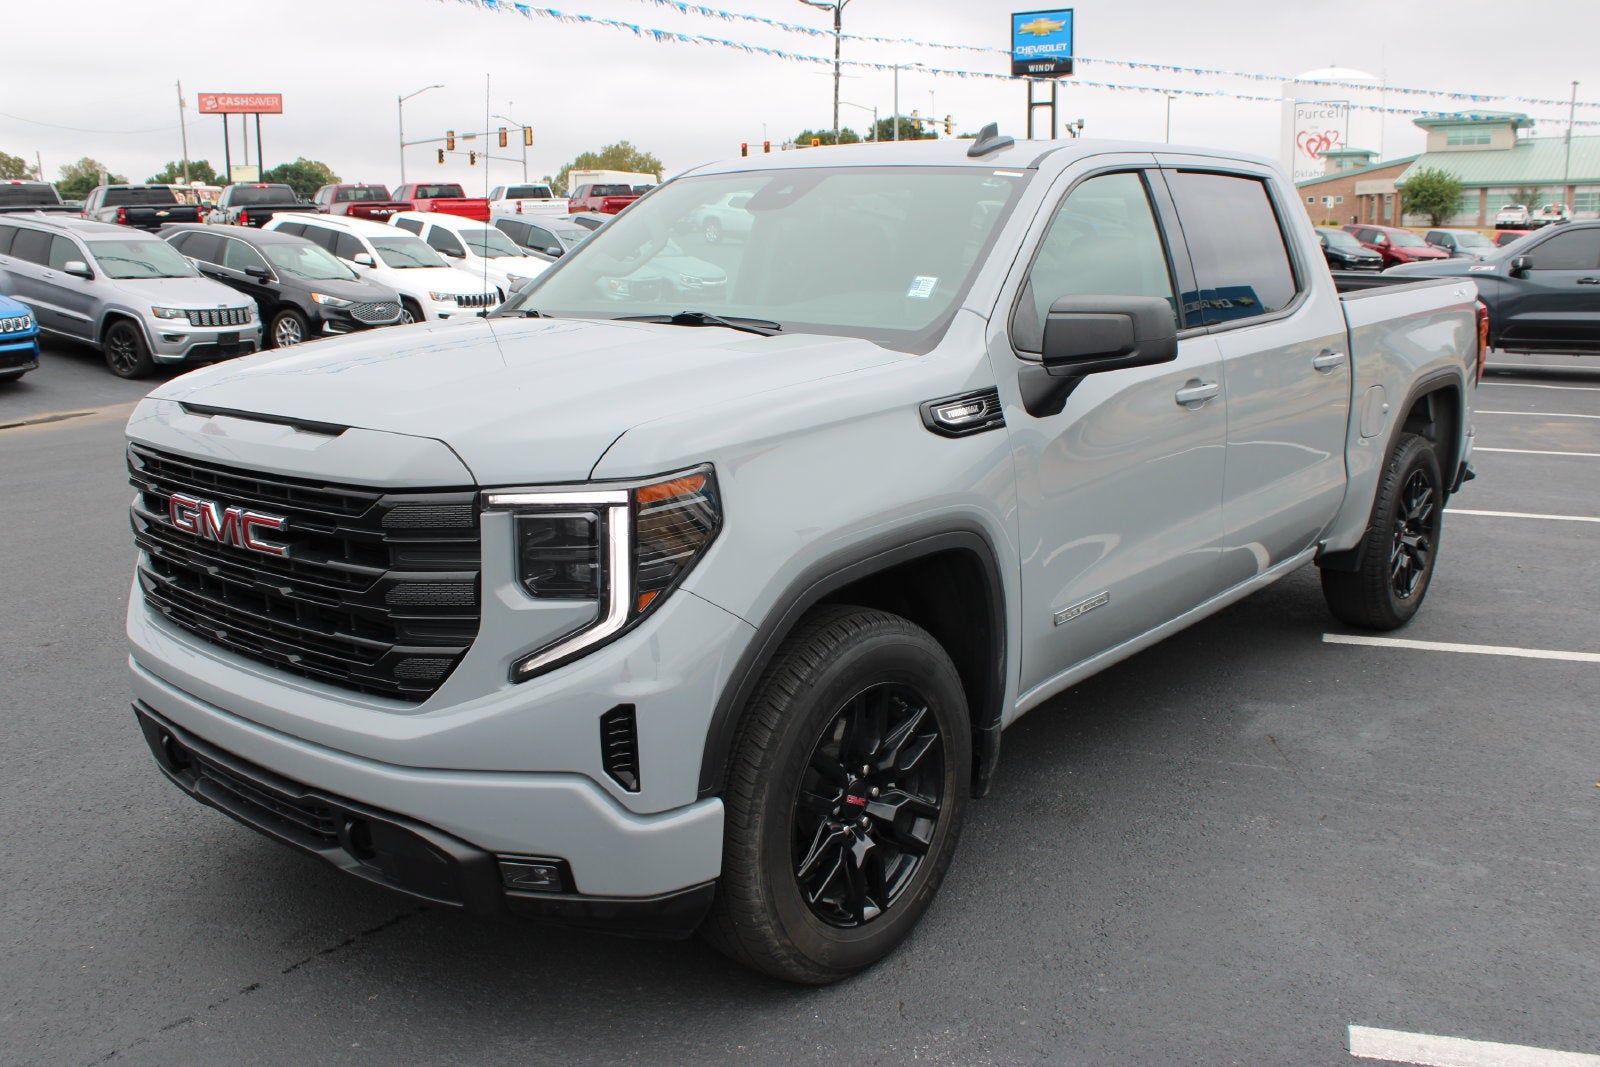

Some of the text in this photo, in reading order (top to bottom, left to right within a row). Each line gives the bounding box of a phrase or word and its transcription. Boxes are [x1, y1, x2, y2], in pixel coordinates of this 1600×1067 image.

[1016, 42, 1067, 55] CHEVROLET
[1028, 63, 1055, 72] WINDY
[217, 96, 279, 106] CASHSAVER
[1297, 106, 1344, 120] Purcell
[1294, 168, 1326, 178] Oklaho
[169, 493, 290, 558] GMC
[846, 794, 867, 807] GMC
